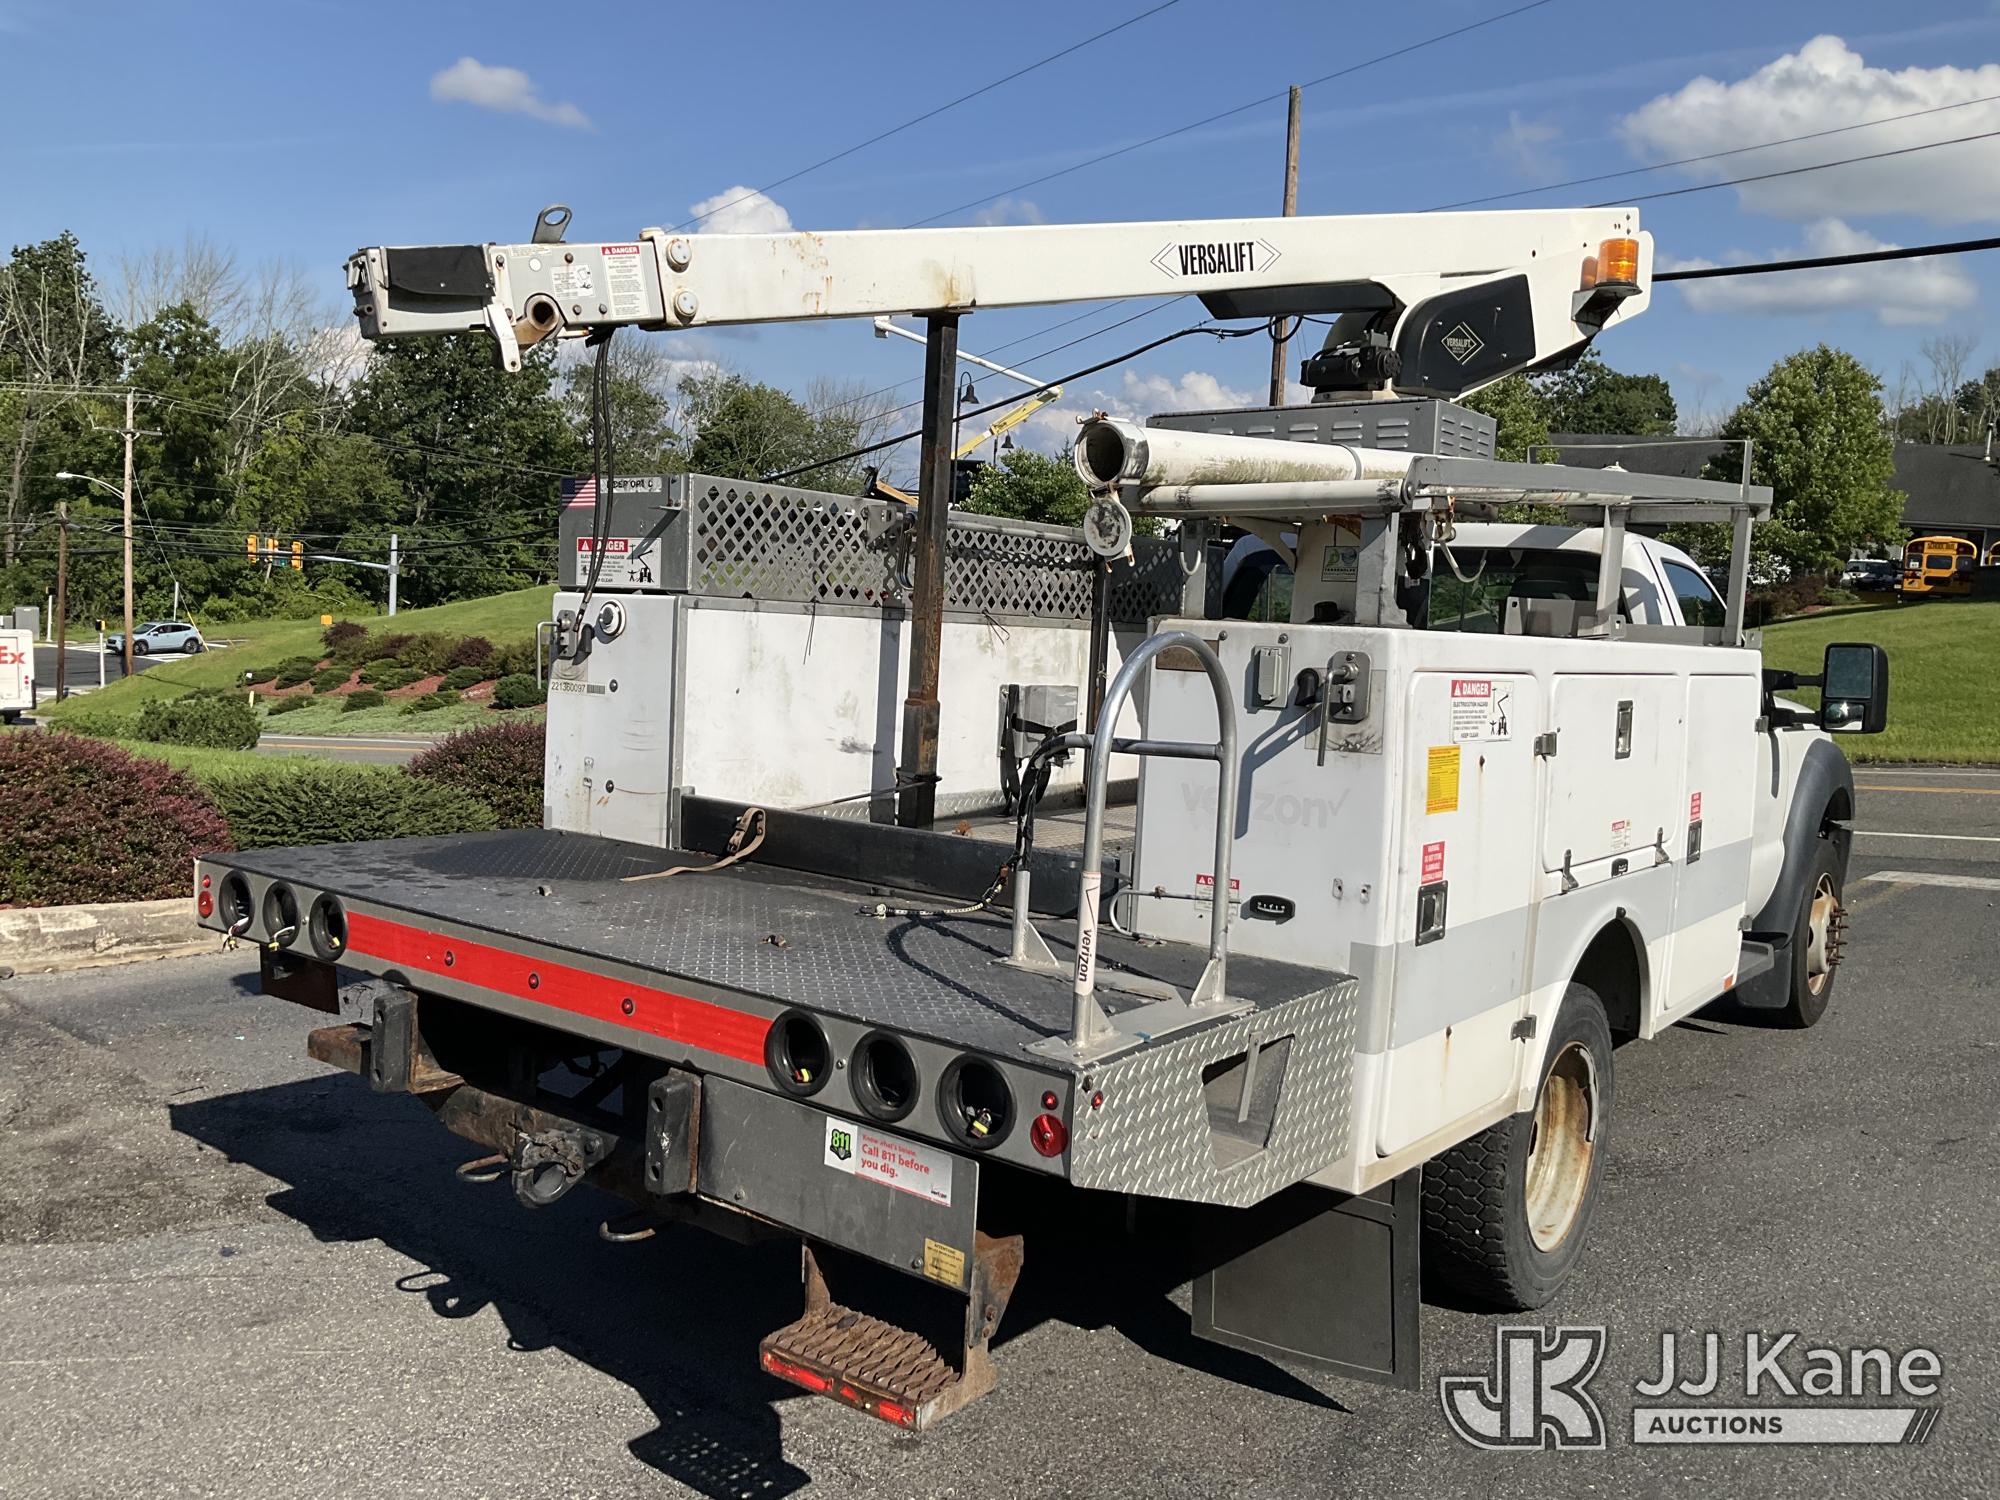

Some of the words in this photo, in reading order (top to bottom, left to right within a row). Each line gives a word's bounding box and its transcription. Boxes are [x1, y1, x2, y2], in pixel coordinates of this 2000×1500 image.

[611, 246, 638, 254] DANGER
[1178, 241, 1255, 276] VERSALIFT
[1462, 682, 1489, 696] DANGER
[1079, 928, 1092, 983] verizon
[832, 1130, 850, 1151] 811
[861, 1158, 878, 1170] you
[880, 1163, 898, 1178] dig.
[862, 1143, 879, 1158] Call
[881, 1150, 896, 1163] 811
[898, 1154, 930, 1174] before
